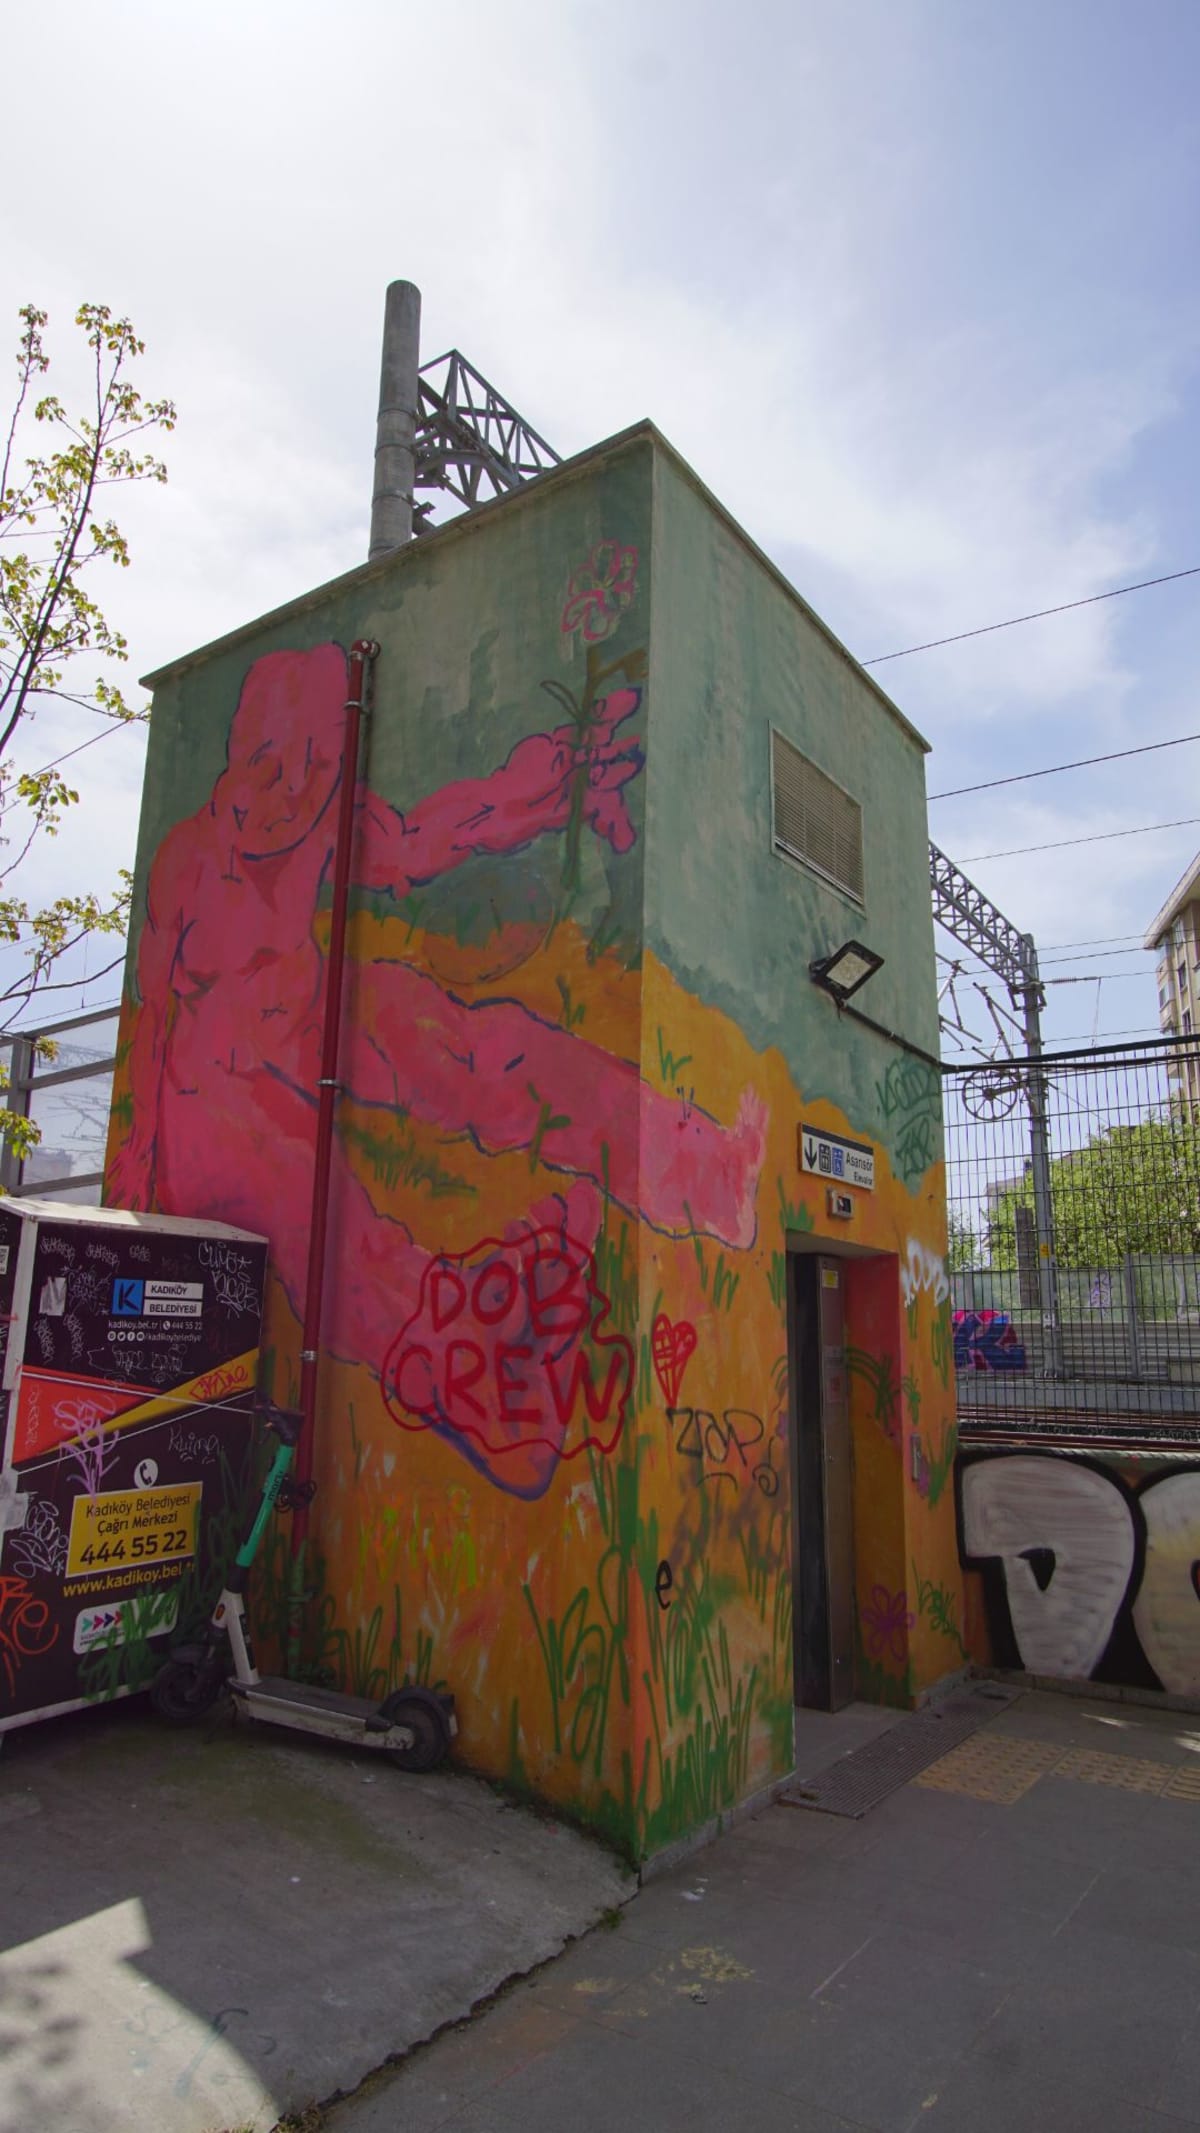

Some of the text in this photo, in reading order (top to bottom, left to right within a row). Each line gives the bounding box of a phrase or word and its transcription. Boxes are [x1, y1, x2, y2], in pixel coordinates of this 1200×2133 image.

[846, 1152, 872, 1171] Asansör
[151, 1284, 188, 1296] KADIKÖY
[430, 1249, 591, 1337] DOB
[149, 1302, 197, 1314] BELEDİYESİ
[396, 1339, 624, 1425] CREW
[86, 1493, 192, 1519] Kadıköy Belediyesi
[97, 1511, 178, 1537] Çağrı Merkezi
[80, 1530, 187, 1566] 444 55 22
